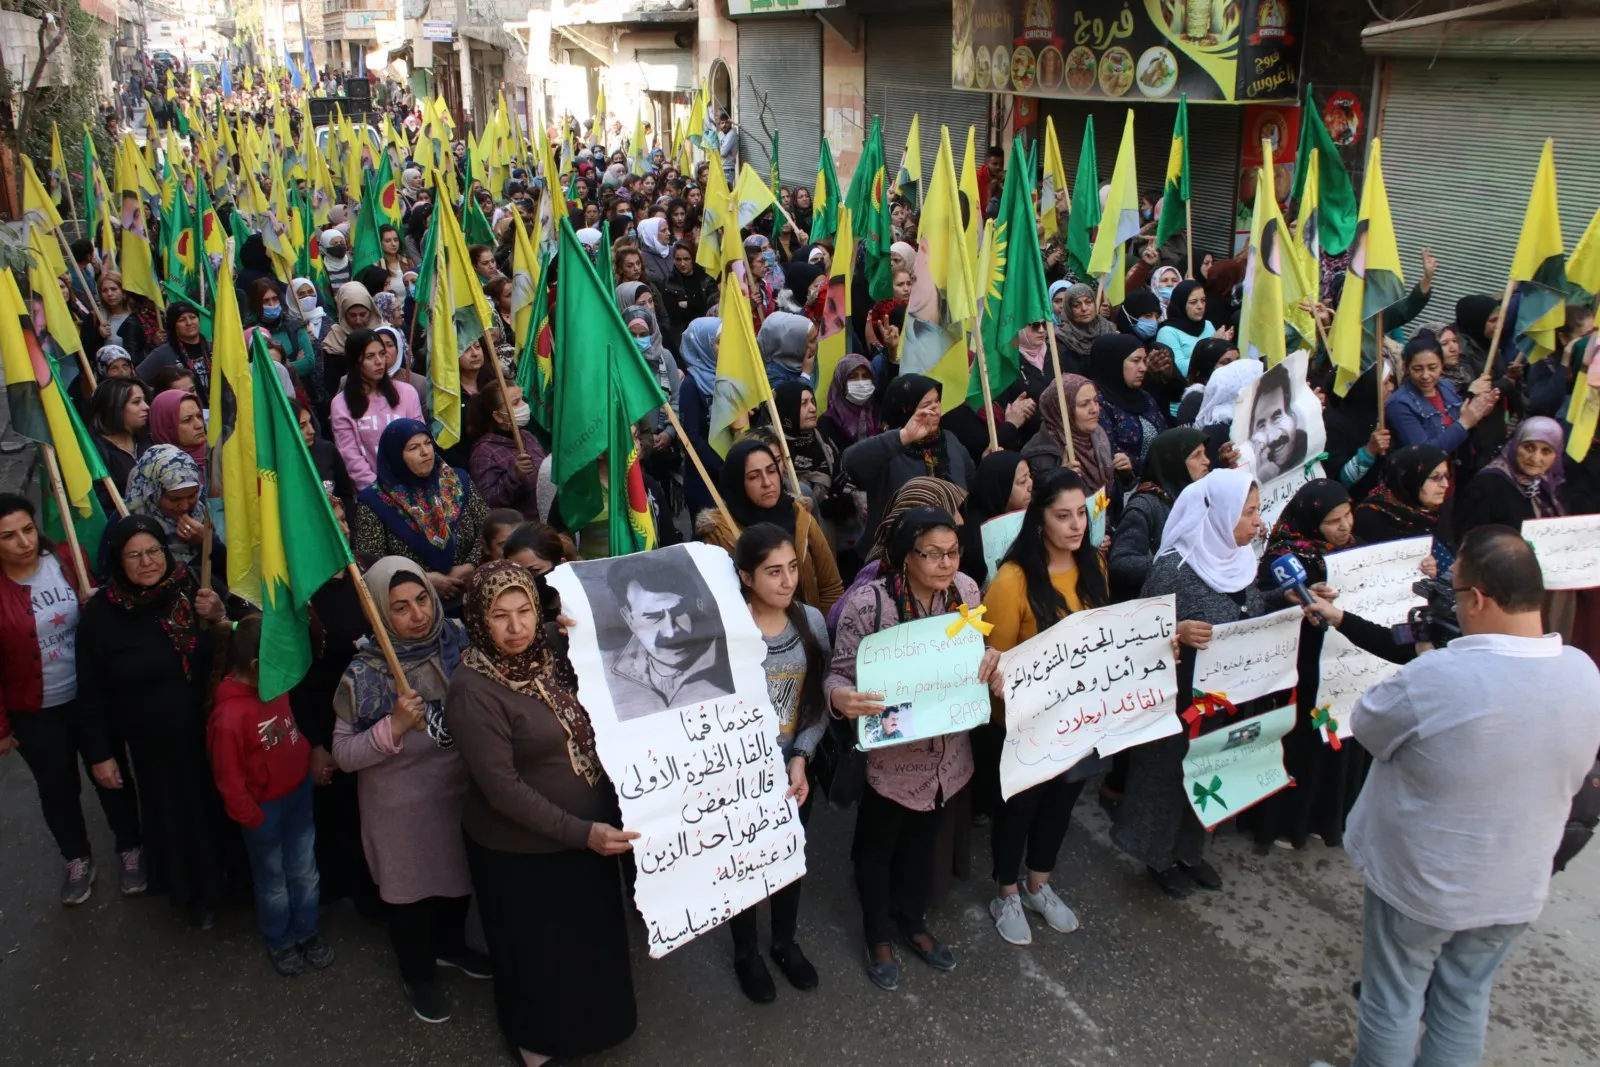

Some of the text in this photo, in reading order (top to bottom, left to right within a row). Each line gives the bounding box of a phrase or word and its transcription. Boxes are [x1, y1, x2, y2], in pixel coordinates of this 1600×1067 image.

[1025, 30, 1052, 39] CHICKEN
[1073, 2, 1134, 50] فروج
[1273, 566, 1291, 582] R
[1288, 557, 1303, 573] R
[1070, 627, 1114, 669] المجتمع
[1138, 659, 1168, 681] هو
[1112, 687, 1165, 716] القائد
[680, 703, 763, 742] عندما قمنا
[686, 743, 732, 786] الخطوة
[682, 769, 774, 824] قال البعض
[651, 908, 709, 950] سياسية
